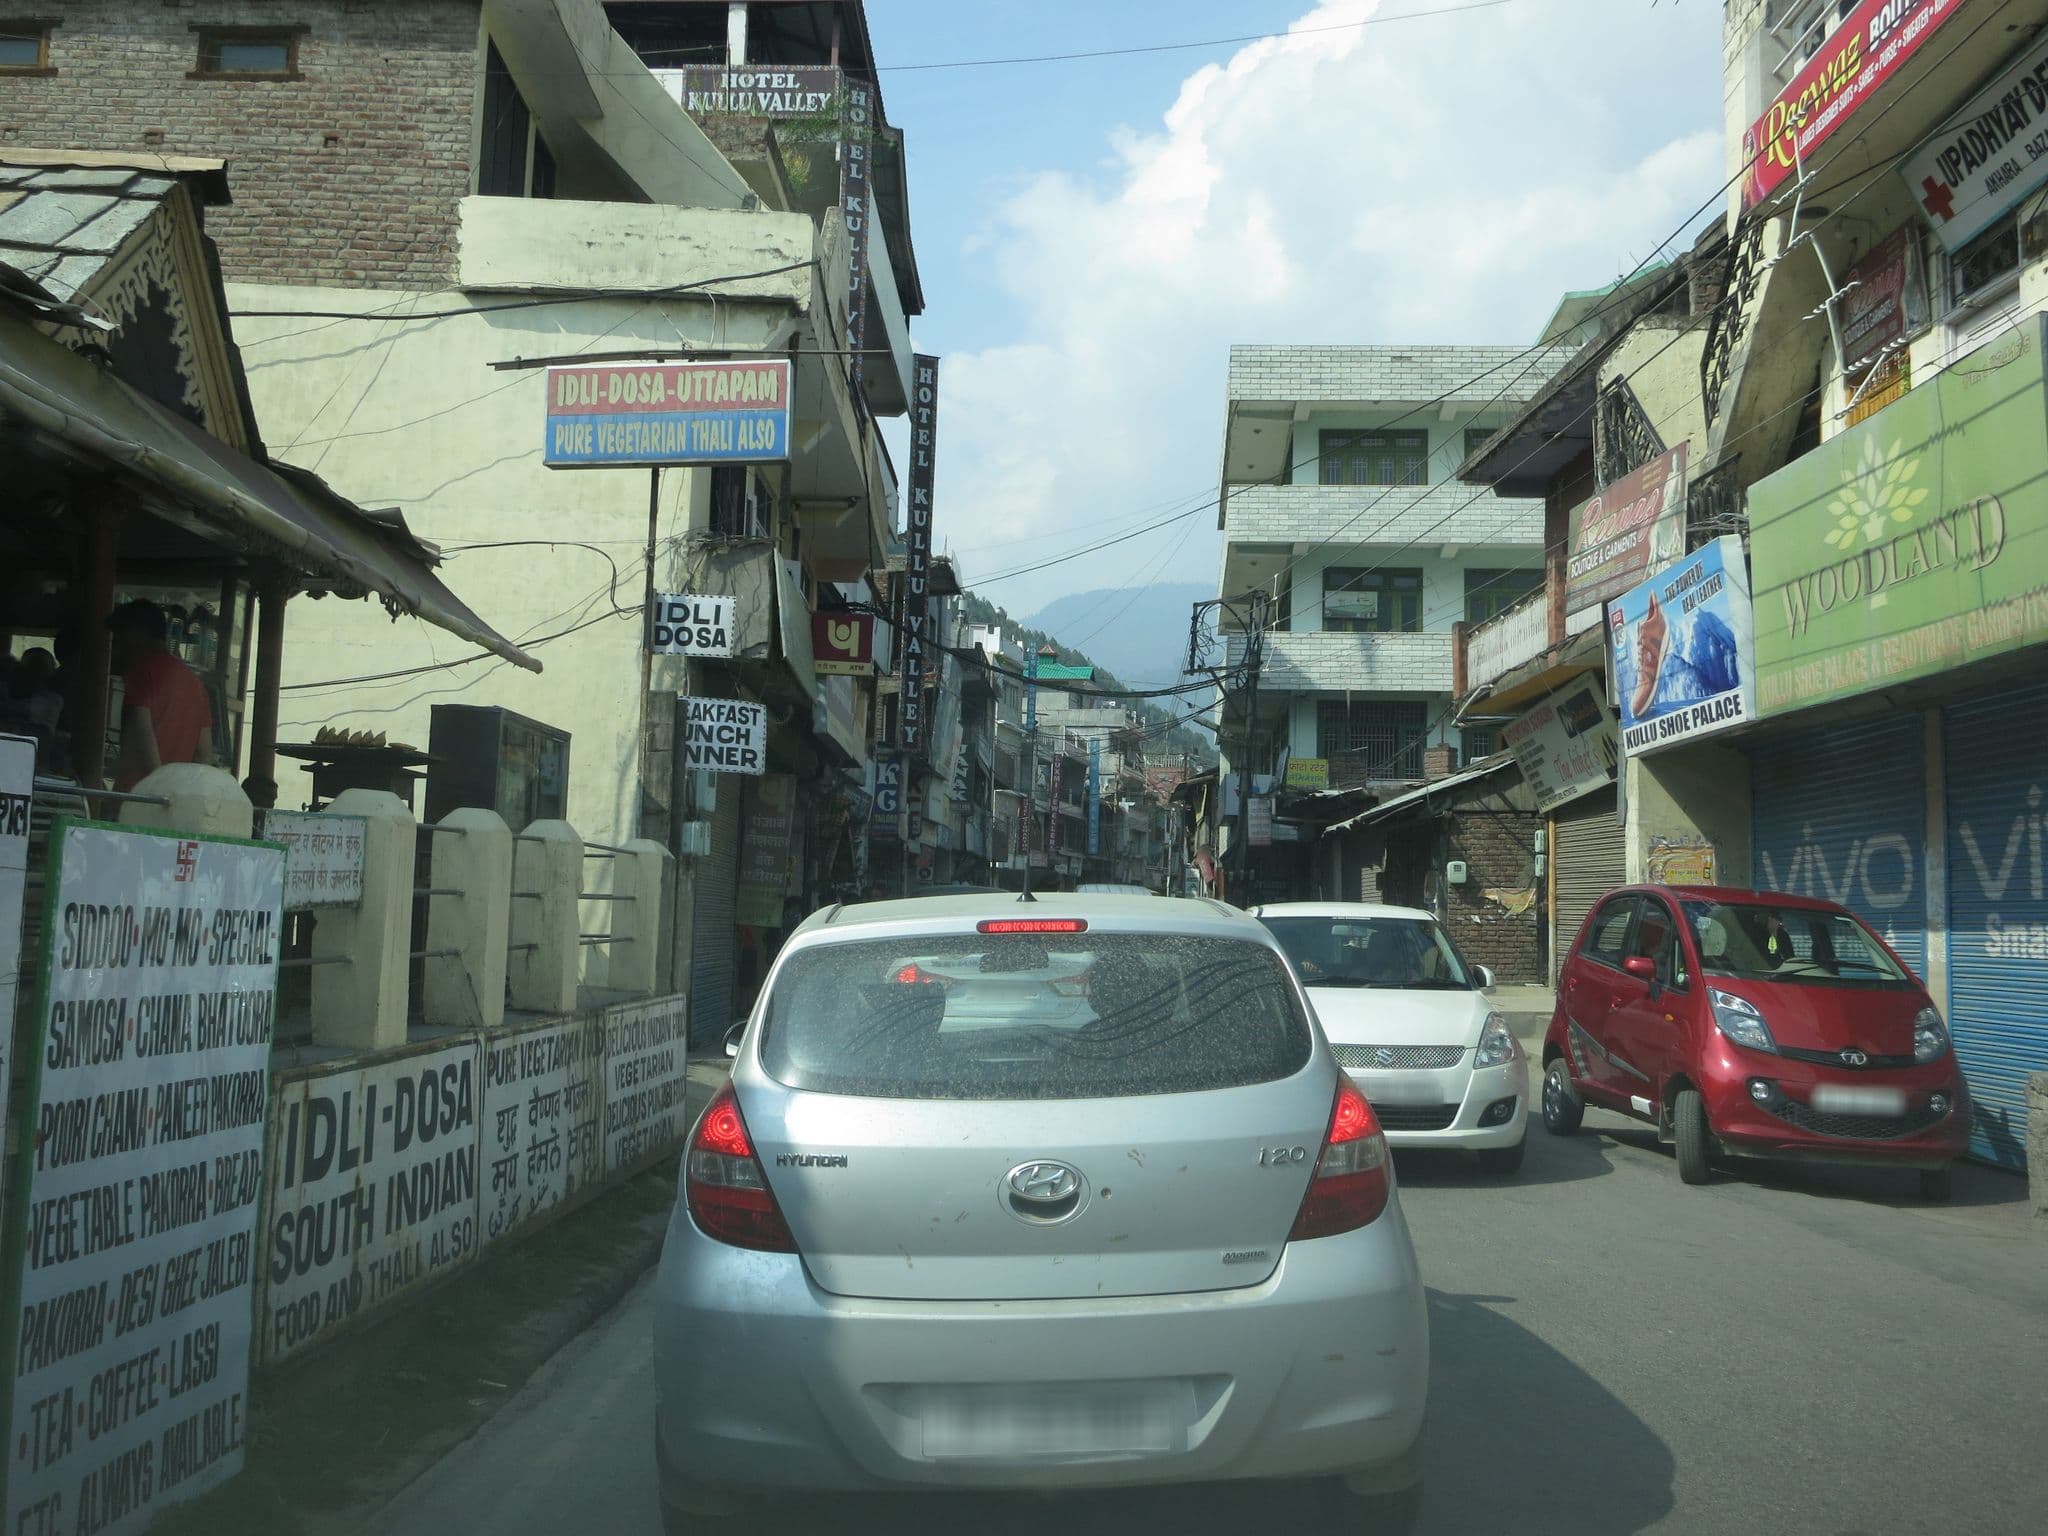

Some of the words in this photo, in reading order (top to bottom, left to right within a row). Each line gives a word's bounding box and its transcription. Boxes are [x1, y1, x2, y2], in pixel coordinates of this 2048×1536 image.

[721, 73, 800, 89] HOTEL
[757, 91, 832, 112] VALLEY
[849, 90, 866, 179] HOTEL
[1935, 85, 2031, 188] UPADHYAY
[1984, 156, 2023, 196] AKHARA
[846, 196, 863, 291] KULLU
[556, 368, 779, 407] IDLI-DOSA-UTTAPAM
[917, 366, 933, 468] HOTEL
[555, 422, 593, 456] PURE
[598, 420, 687, 455] VEGETARIAN
[691, 418, 733, 451] THALI
[738, 417, 775, 450] ALSO
[910, 486, 929, 595] KULLU
[1571, 548, 1599, 579] BOUTIQUE
[1605, 531, 1638, 562] GARMENTS
[1782, 493, 2007, 640] WOODLAND
[653, 625, 727, 649] DOSA
[656, 601, 722, 626] IDLI
[904, 615, 923, 743] VALLEY
[1625, 722, 1658, 750] KULLU
[1659, 710, 1691, 739] SHOE
[1691, 693, 1743, 729] PALACE
[47, 998, 128, 1070] SAMOSA
[134, 993, 192, 1058] CHANA
[487, 1043, 518, 1089] PURE
[520, 1030, 581, 1081] VEGETARIAN
[614, 1048, 674, 1092] VEGETARIAN
[37, 1096, 91, 1172] POORI
[90, 1086, 149, 1159] CHANA
[153, 1078, 208, 1145] PANEER
[284, 1059, 473, 1190] IDLI-DOSA
[606, 1090, 647, 1137] DELICIOUS
[776, 1152, 848, 1168] HYUNDAI
[1258, 1146, 1305, 1167] i20
[31, 1179, 134, 1270] VEGETABLE
[139, 1160, 208, 1239] PAKORRA
[272, 1183, 376, 1286] SOUTH
[385, 1144, 476, 1236] INDIAN
[18, 1280, 108, 1377] PAKORRA
[115, 1262, 161, 1338] DESI
[160, 1247, 203, 1318] GHEE
[200, 1228, 251, 1300] JALEBI
[274, 1290, 322, 1352] FOOD
[324, 1270, 363, 1326] AND
[369, 1241, 421, 1298] THALI
[428, 1215, 473, 1272] ALSO
[31, 1386, 74, 1475] TEA
[88, 1346, 160, 1441] COFFEE
[169, 1320, 221, 1399] LASSI
[77, 1439, 153, 1536] ALWAYS
